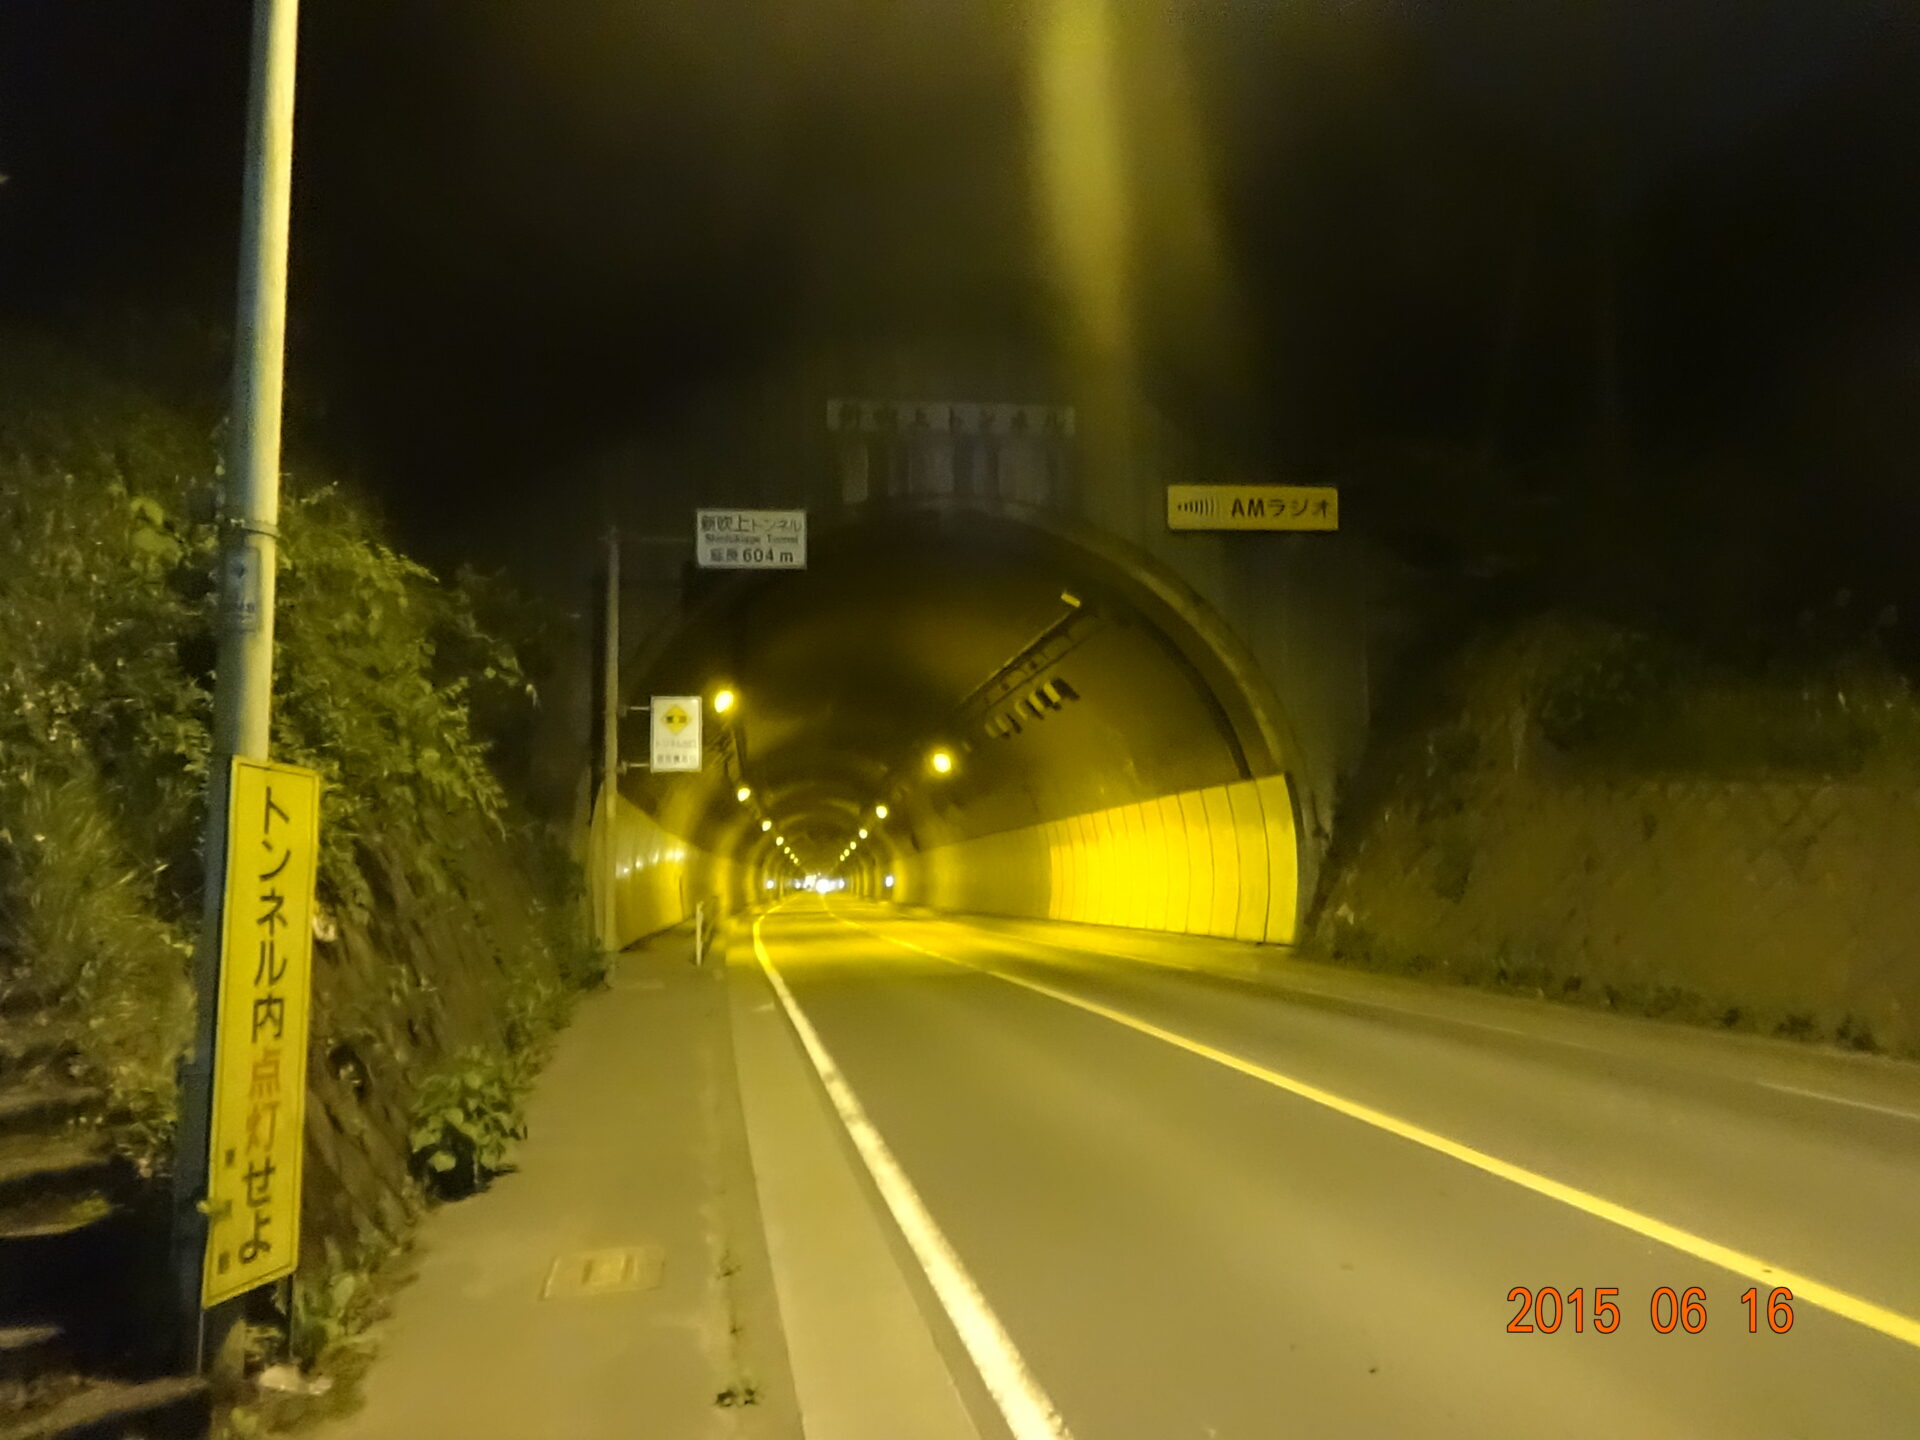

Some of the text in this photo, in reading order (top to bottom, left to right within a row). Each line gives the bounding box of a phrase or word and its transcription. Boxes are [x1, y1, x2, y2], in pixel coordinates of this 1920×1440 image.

[1231, 498, 1330, 518] AMラジオ
[238, 786, 290, 1265] トンネル内点灯せよ
